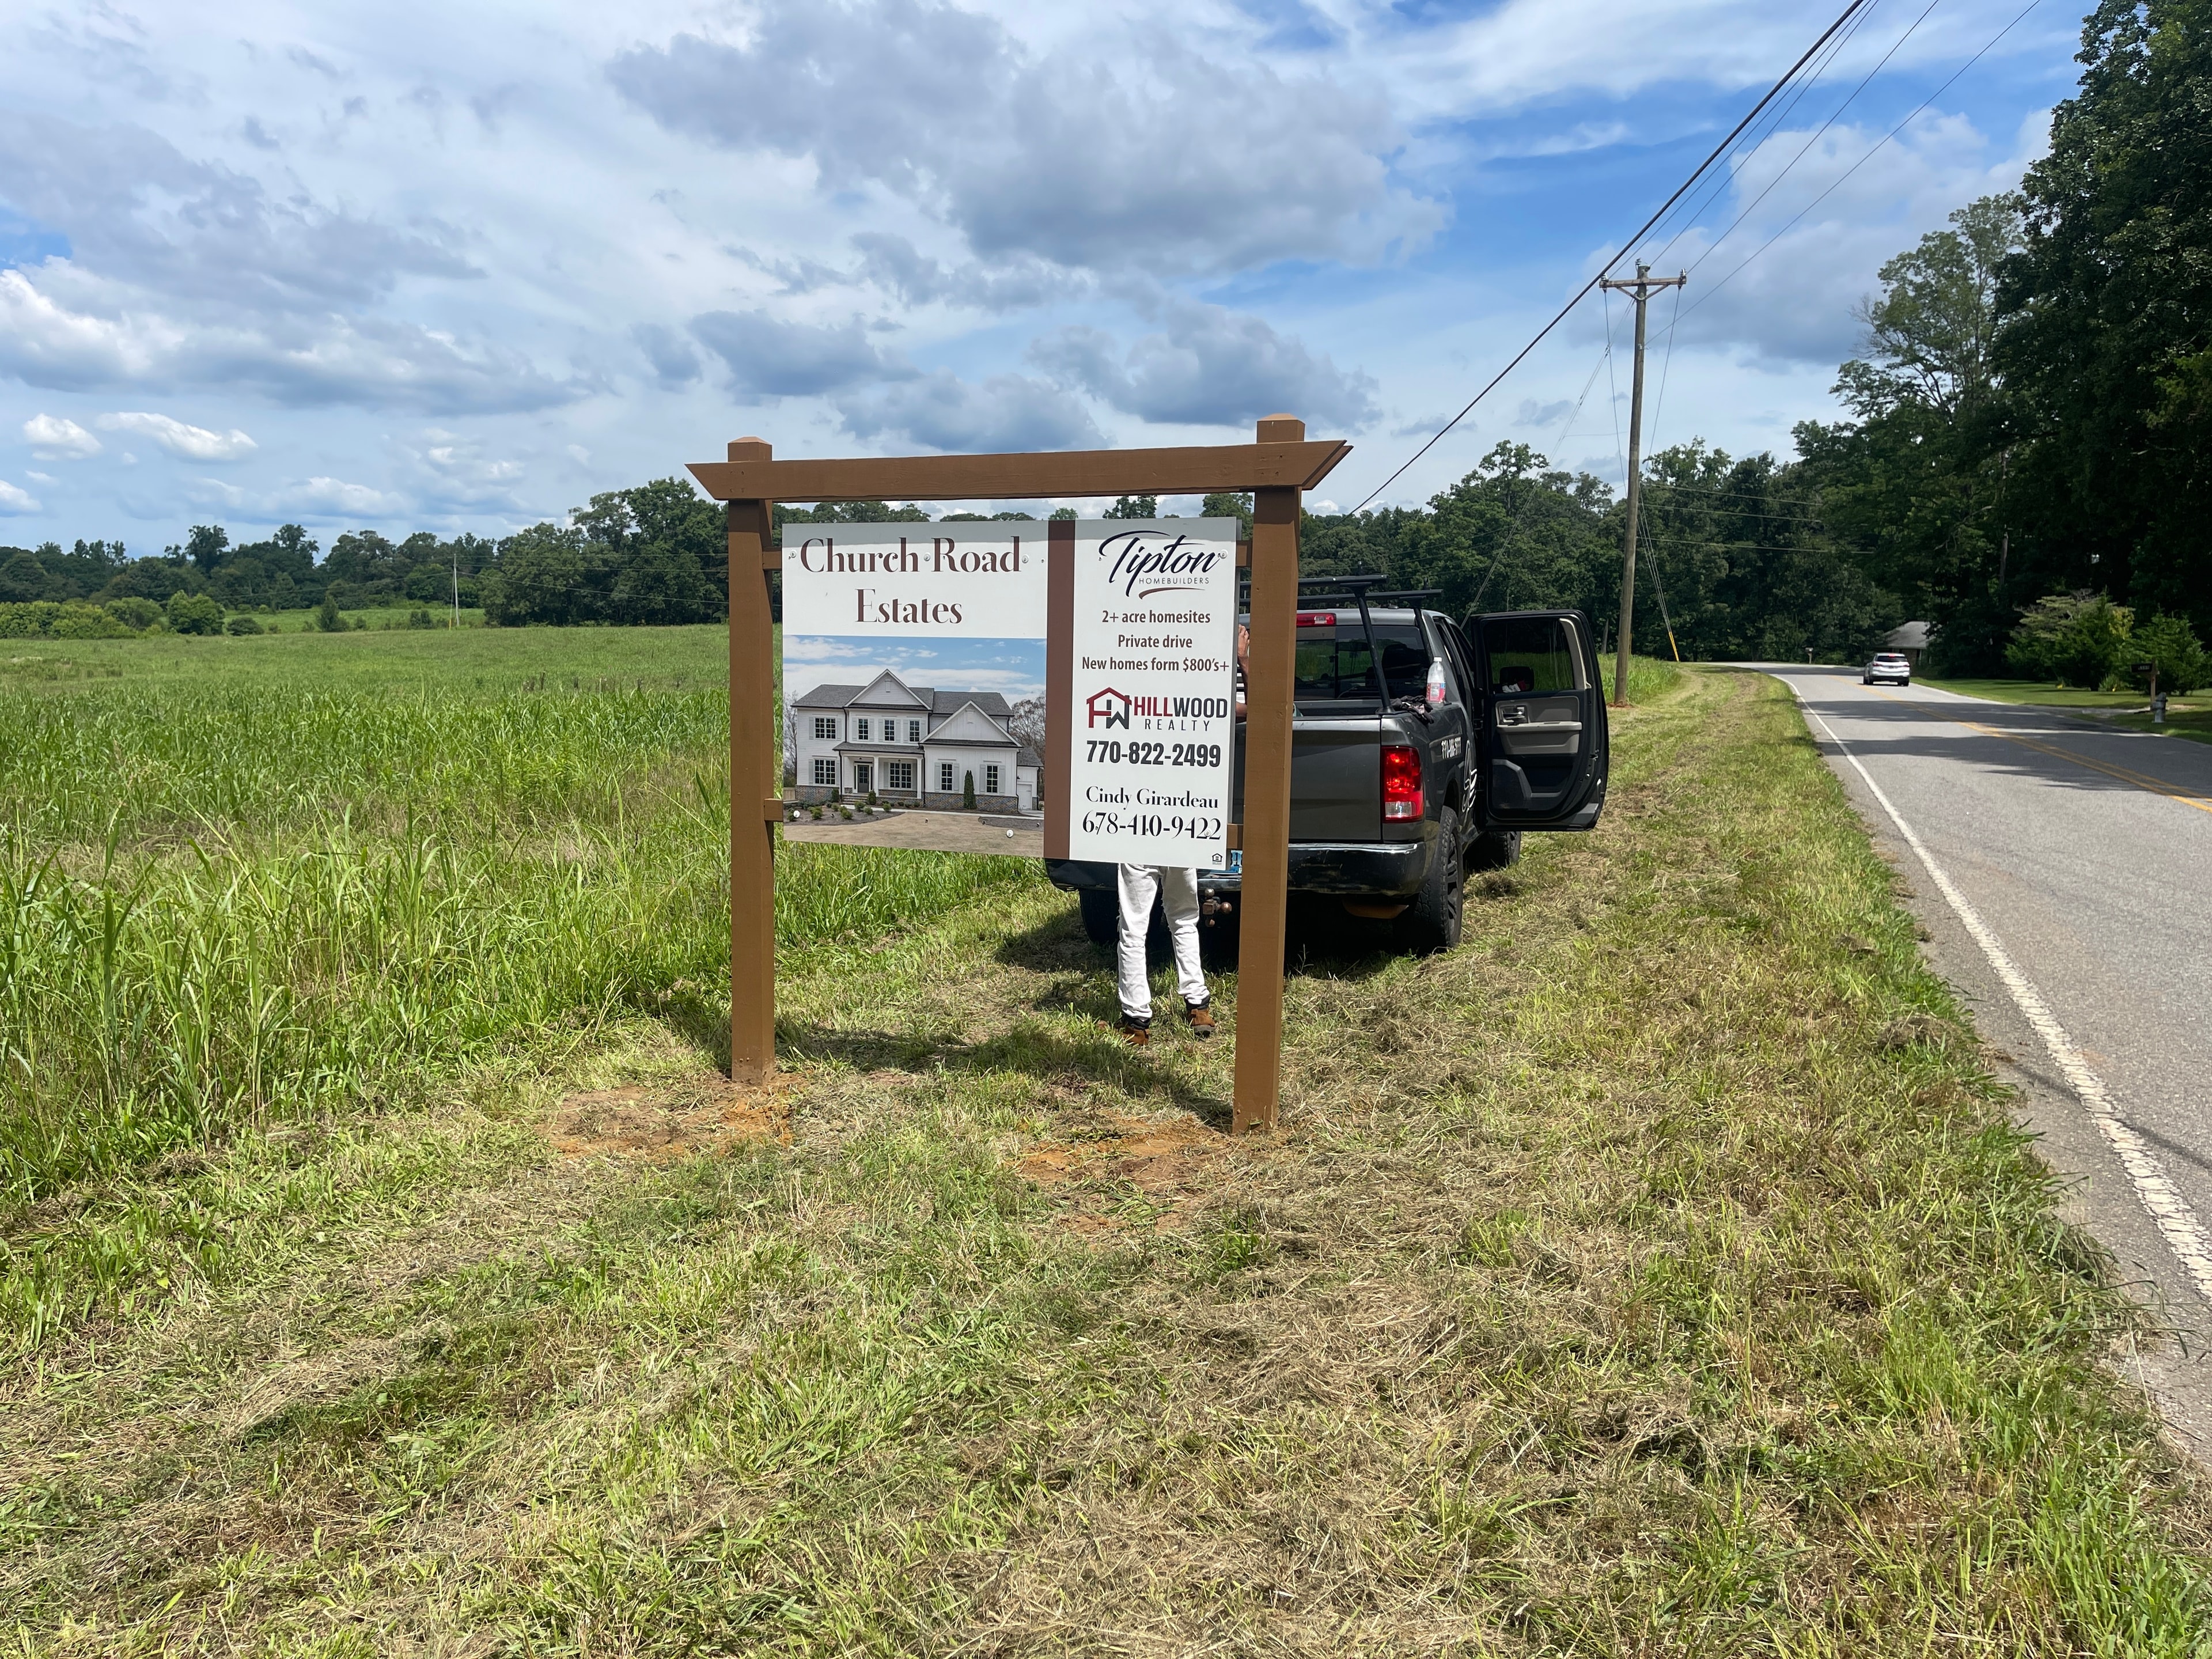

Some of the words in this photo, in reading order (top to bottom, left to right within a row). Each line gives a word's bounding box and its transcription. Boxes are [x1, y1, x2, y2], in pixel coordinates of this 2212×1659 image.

[800, 536, 919, 573] Church
[930, 536, 1021, 573] Road
[1099, 530, 1220, 597] Tipton
[855, 589, 963, 624] Estates
[1101, 609, 1119, 623] 2+
[1121, 612, 1146, 623] acre
[1149, 609, 1211, 624] homesites
[1118, 634, 1160, 648] Private
[1162, 634, 1193, 649] drive
[1082, 657, 1107, 670] New
[1109, 656, 1148, 671] homes
[1150, 657, 1179, 671] form
[1133, 696, 1228, 719] HILLWOOD
[1144, 718, 1210, 732] REALTY
[1086, 740, 1221, 768] 770-822-2499
[1086, 785, 1132, 811] Cindy
[1136, 787, 1218, 809] Girardeau
[1082, 810, 1221, 840] 678-410-9422
